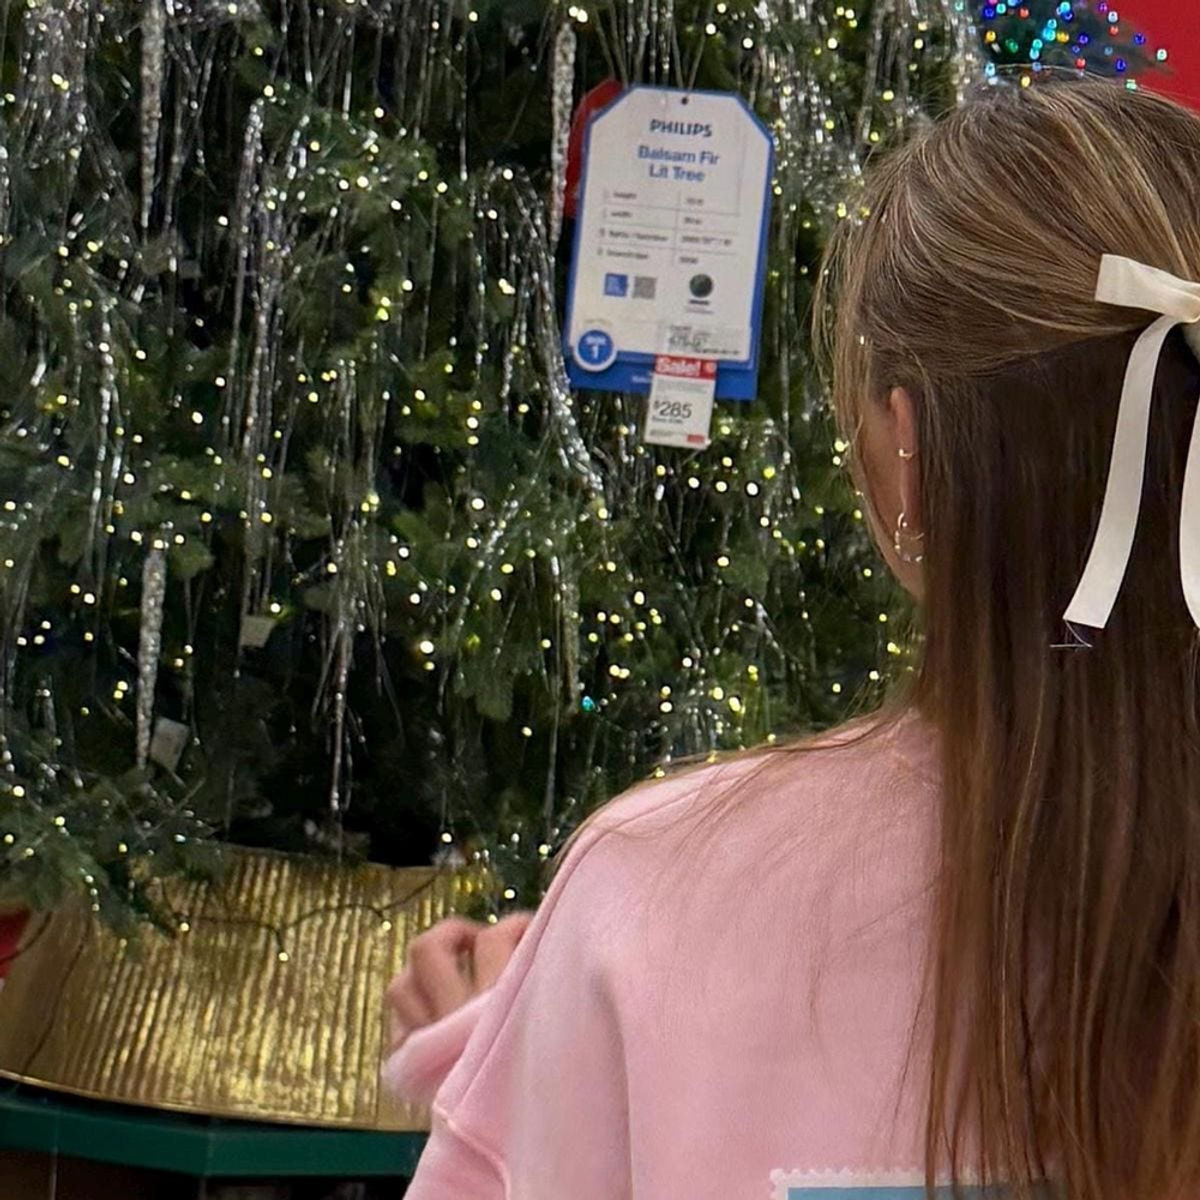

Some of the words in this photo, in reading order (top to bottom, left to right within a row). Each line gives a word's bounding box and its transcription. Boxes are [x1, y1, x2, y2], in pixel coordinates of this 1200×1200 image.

[649, 119, 712, 137] PHILIPS
[638, 145, 696, 162] Balsam
[673, 166, 705, 181] Tree
